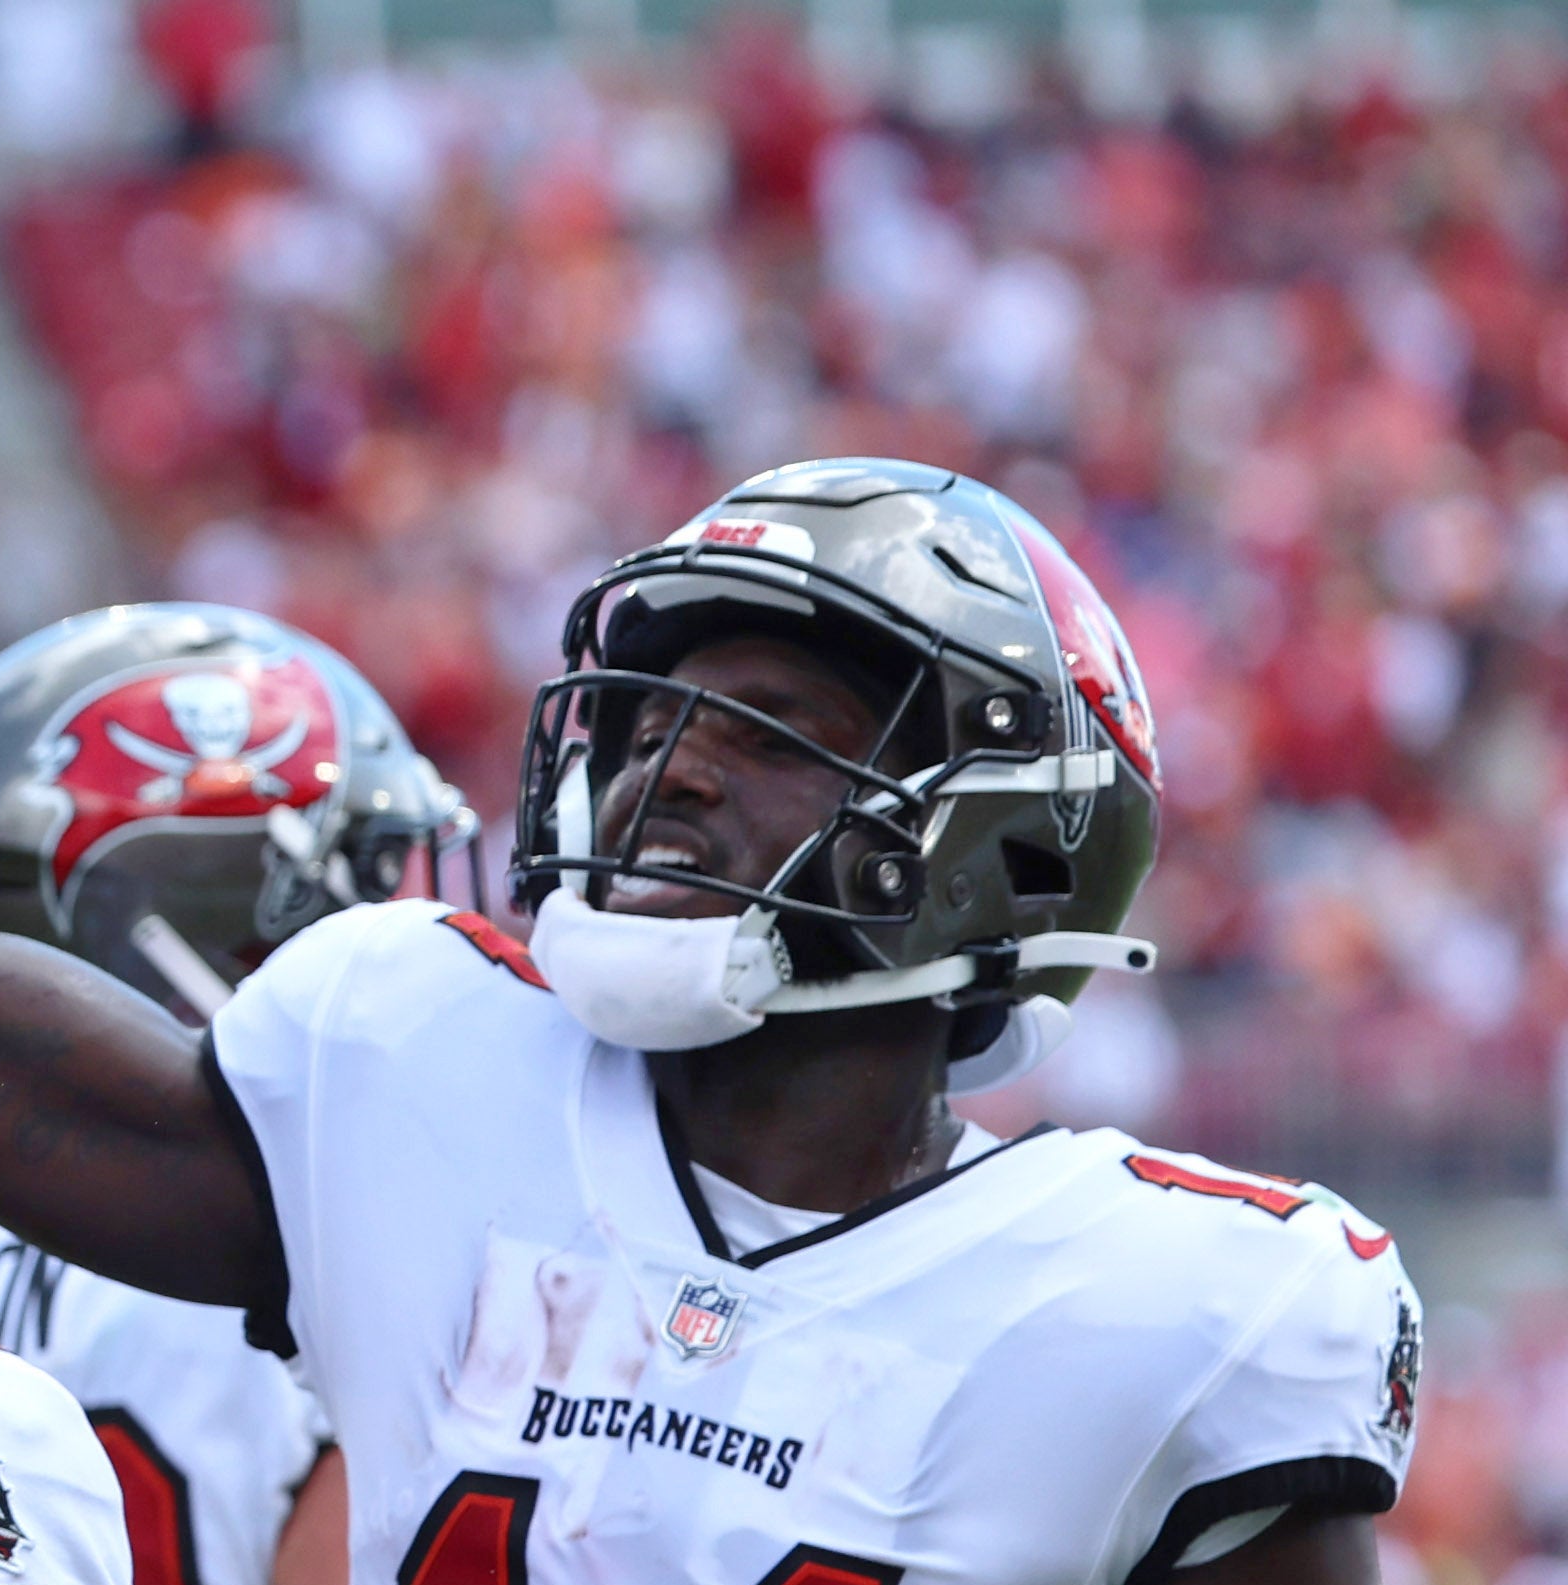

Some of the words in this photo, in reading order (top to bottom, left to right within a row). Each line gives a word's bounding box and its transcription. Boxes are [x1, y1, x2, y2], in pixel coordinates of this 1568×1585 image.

[1121, 1154, 1314, 1222] 1
[670, 1303, 721, 1343] NFL
[521, 1386, 804, 1490] BUCCANEERS
